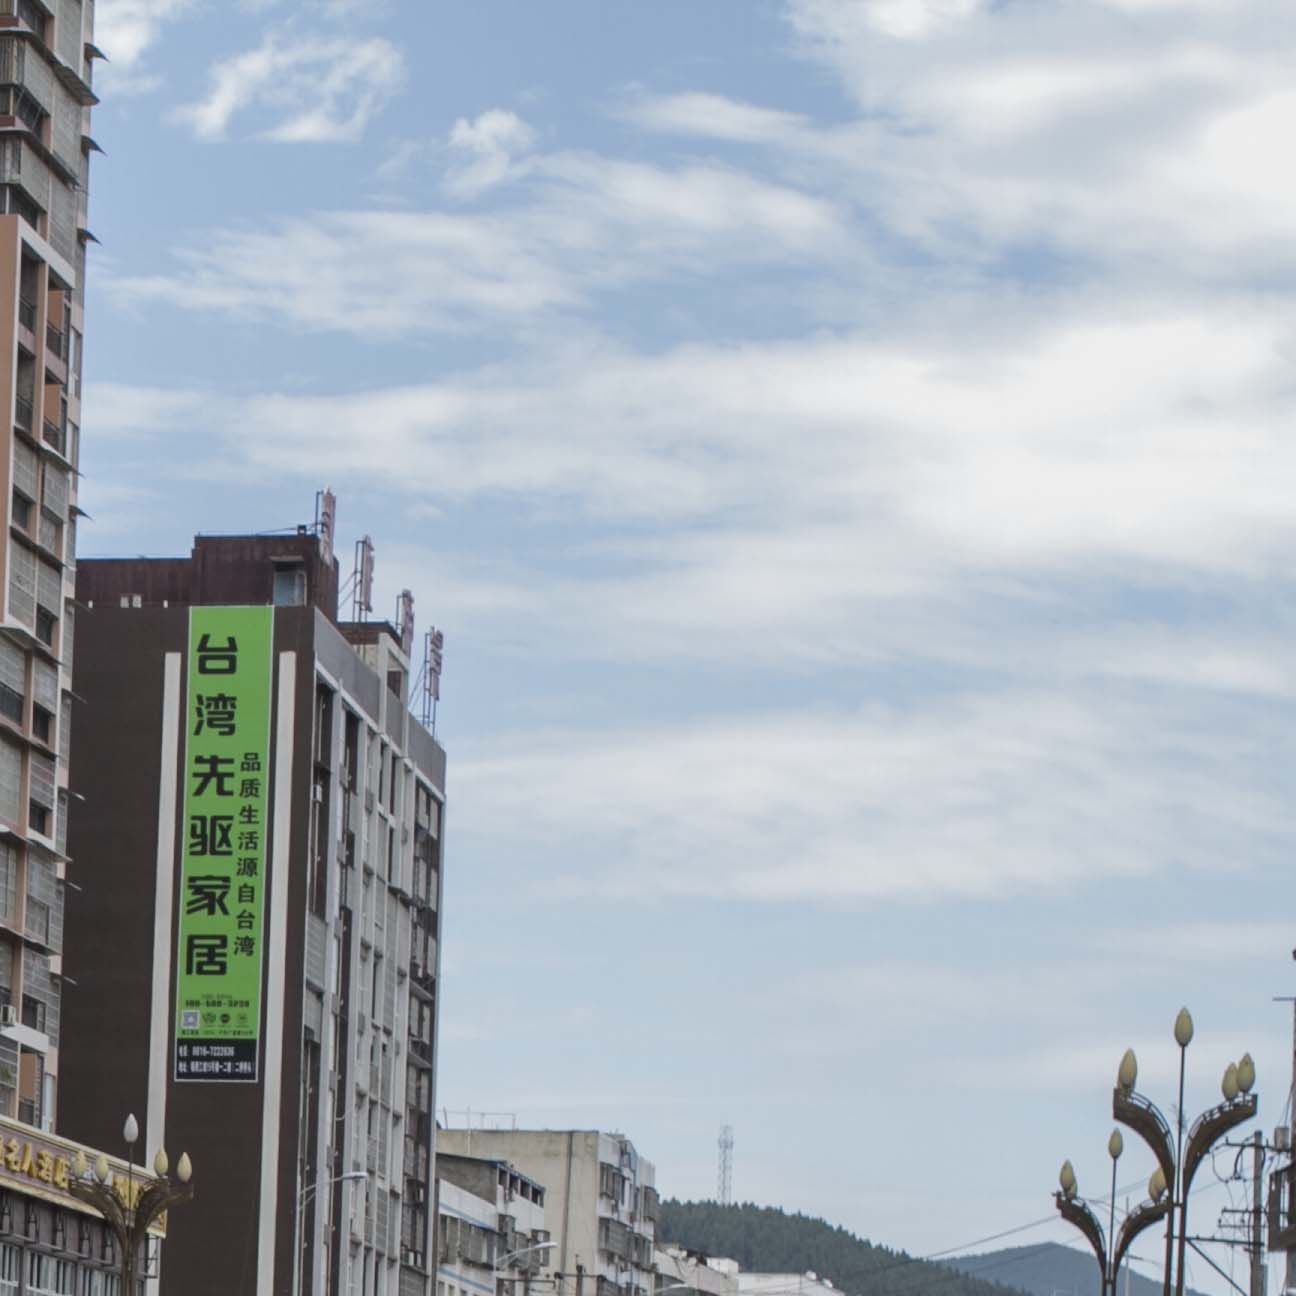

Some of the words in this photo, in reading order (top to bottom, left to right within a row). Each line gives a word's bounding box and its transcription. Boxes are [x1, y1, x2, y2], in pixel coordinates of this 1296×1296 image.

[185, 633, 238, 977] 台湾先驱家居
[233, 752, 262, 957] 品质生活源自台湾
